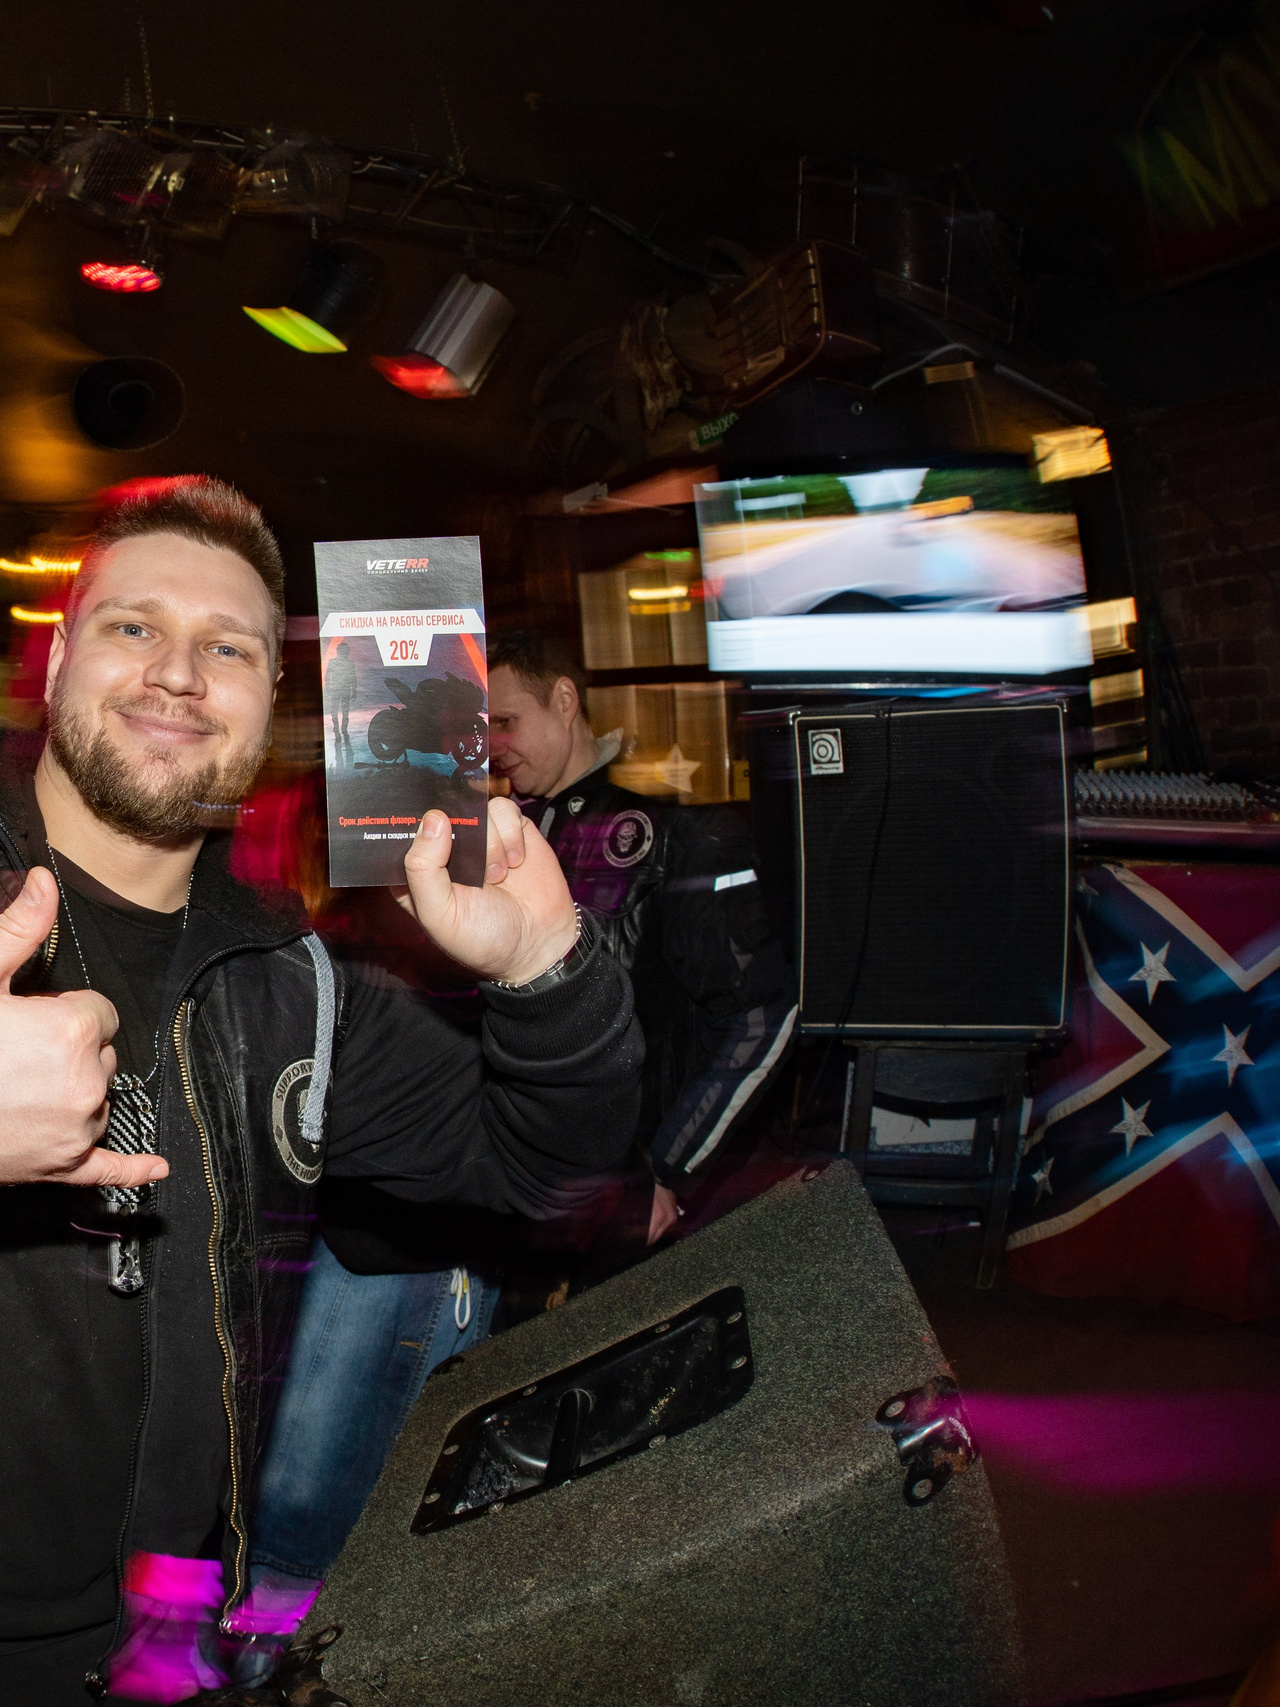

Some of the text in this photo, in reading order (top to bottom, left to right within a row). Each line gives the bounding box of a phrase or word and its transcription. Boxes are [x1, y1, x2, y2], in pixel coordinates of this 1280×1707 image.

[701, 412, 740, 440] ВЫХО
[366, 558, 429, 570] VETERR
[340, 614, 465, 629] СКИДКА НА РАБОТЫ СЕРВИСА
[390, 640, 419, 661] 20%
[339, 816, 357, 827] Срок
[357, 816, 389, 826] действия
[390, 815, 416, 827] флаера
[363, 832, 382, 840] Акции
[388, 832, 408, 840] скидки
[276, 1062, 314, 1101] SUPPORT
[286, 1151, 301, 1174] THE
